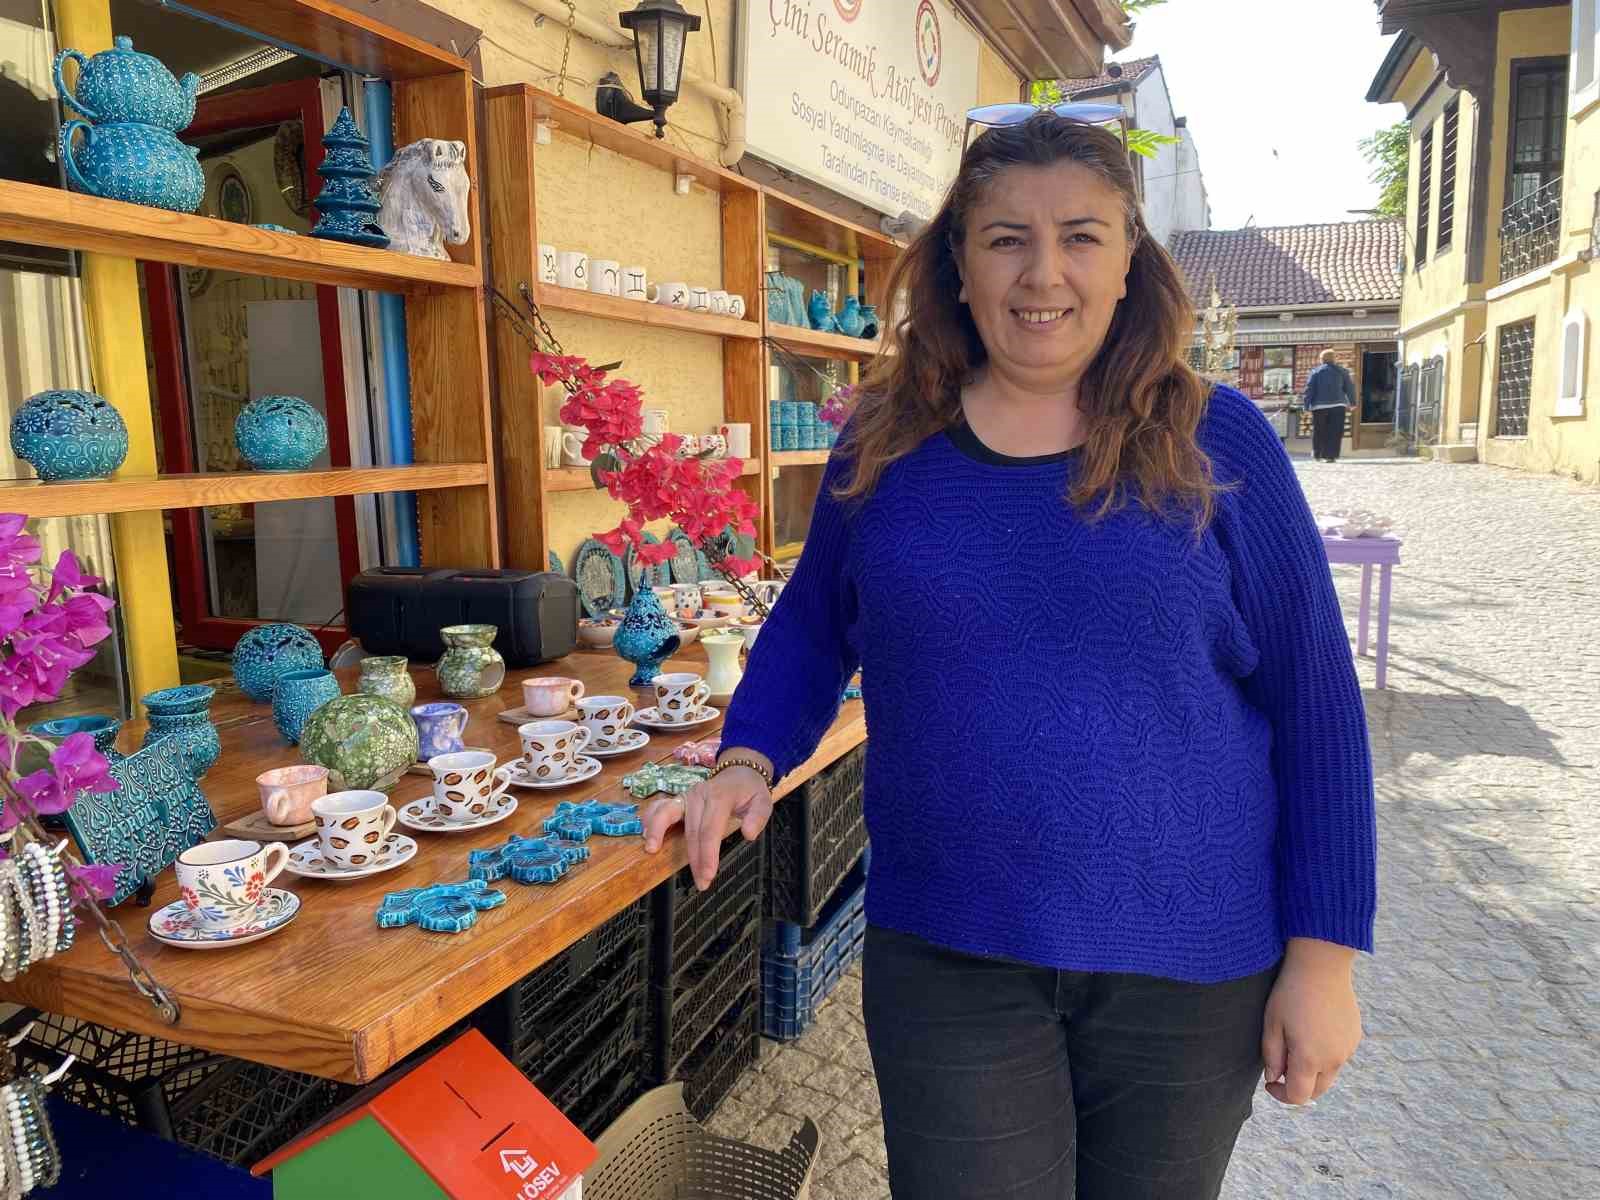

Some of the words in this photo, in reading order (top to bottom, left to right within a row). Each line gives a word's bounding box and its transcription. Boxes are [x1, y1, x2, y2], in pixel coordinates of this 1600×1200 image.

[768, 0, 810, 38] Çini
[811, 13, 878, 98] Seramik
[880, 65, 934, 125] Atölyesi
[934, 102, 965, 152] Projes
[791, 91, 827, 132] Sosyal
[886, 150, 898, 169] ve
[820, 144, 869, 189] Tarafından
